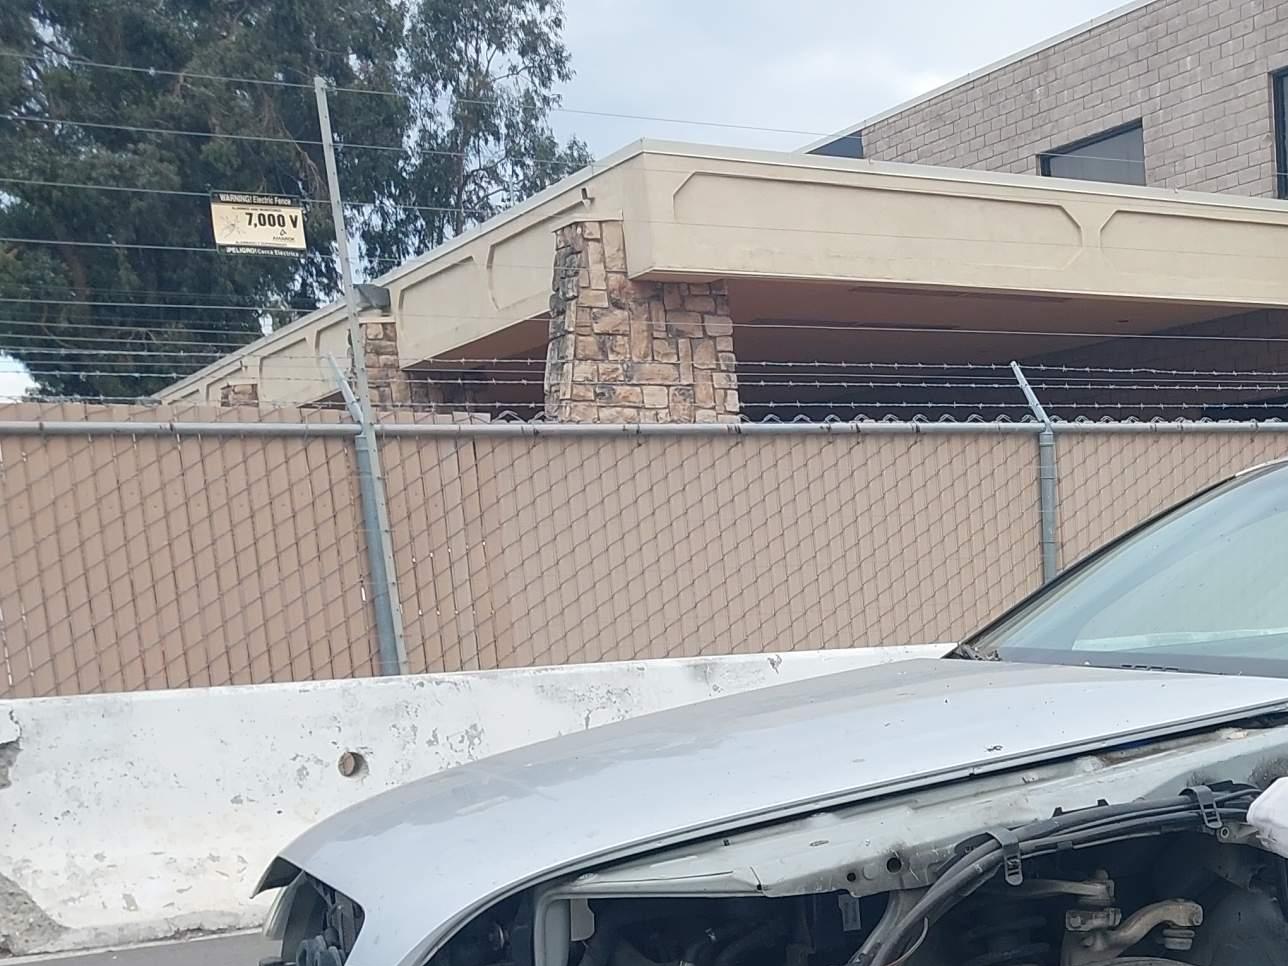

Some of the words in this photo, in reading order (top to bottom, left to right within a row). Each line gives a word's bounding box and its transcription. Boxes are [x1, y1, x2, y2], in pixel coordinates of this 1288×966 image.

[219, 193, 252, 203] WARNING!
[253, 196, 274, 204] Electric
[245, 212, 286, 228] 7,000
[289, 214, 298, 228] V
